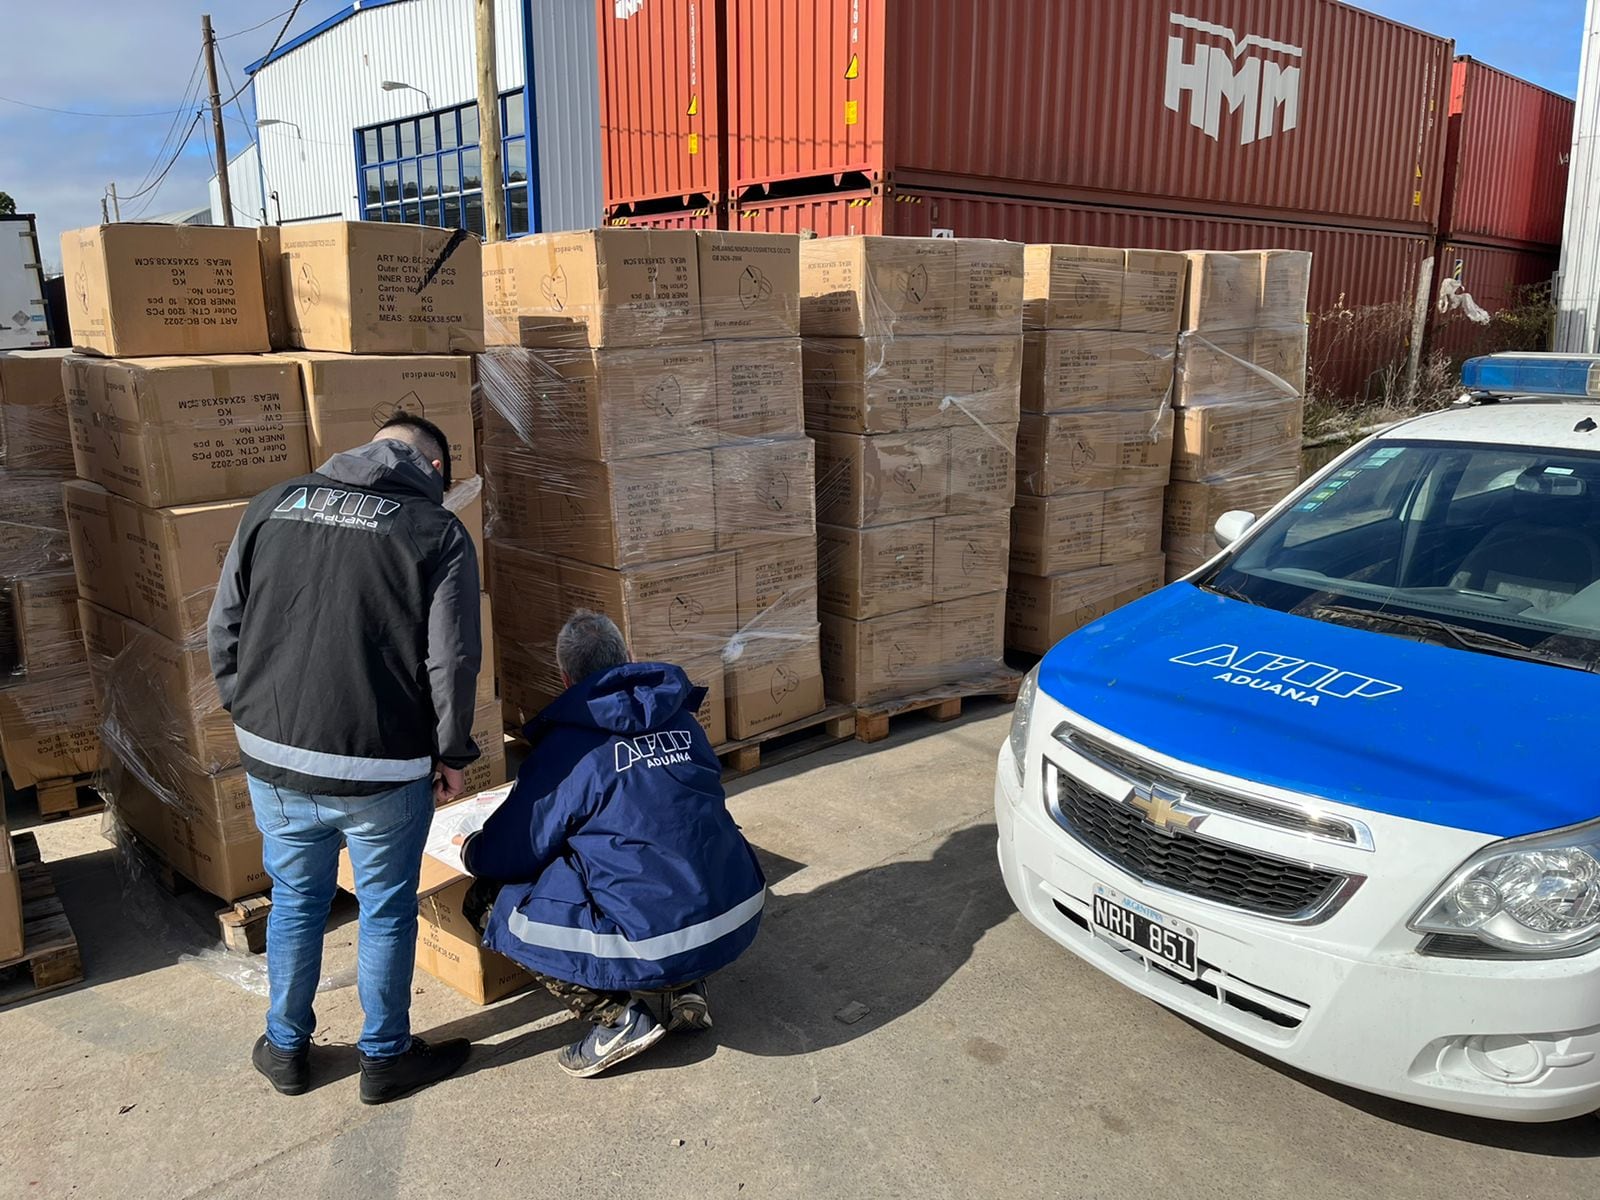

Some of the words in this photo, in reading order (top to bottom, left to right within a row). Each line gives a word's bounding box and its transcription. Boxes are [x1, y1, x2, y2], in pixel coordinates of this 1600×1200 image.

[1164, 24, 1301, 145] HMM
[379, 314, 404, 322] MEAS:
[402, 371, 456, 379] Non-medical
[251, 392, 279, 402] MEAS:
[217, 408, 232, 416] KG
[219, 418, 233, 426] KG
[255, 424, 284, 432] Carton
[232, 437, 254, 445] BOX:
[258, 433, 285, 442] INNER
[193, 439, 210, 448] pcs
[263, 443, 286, 452] Outer
[215, 449, 233, 457] 1200
[238, 446, 258, 455] CTN:
[192, 452, 211, 460] PCS
[269, 453, 288, 462] ART
[275, 487, 400, 518] AFIP
[1169, 644, 1403, 698] AFIP
[1213, 672, 1320, 706] ADUANA
[615, 731, 691, 772] AFIP
[647, 752, 691, 768] ADUANA
[479, 779, 491, 788] ART
[235, 802, 246, 810] GB
[247, 871, 265, 882] Non
[1123, 898, 1163, 923] ARGENTINA
[1096, 897, 1134, 940] NRH
[1150, 924, 1191, 969] 851
